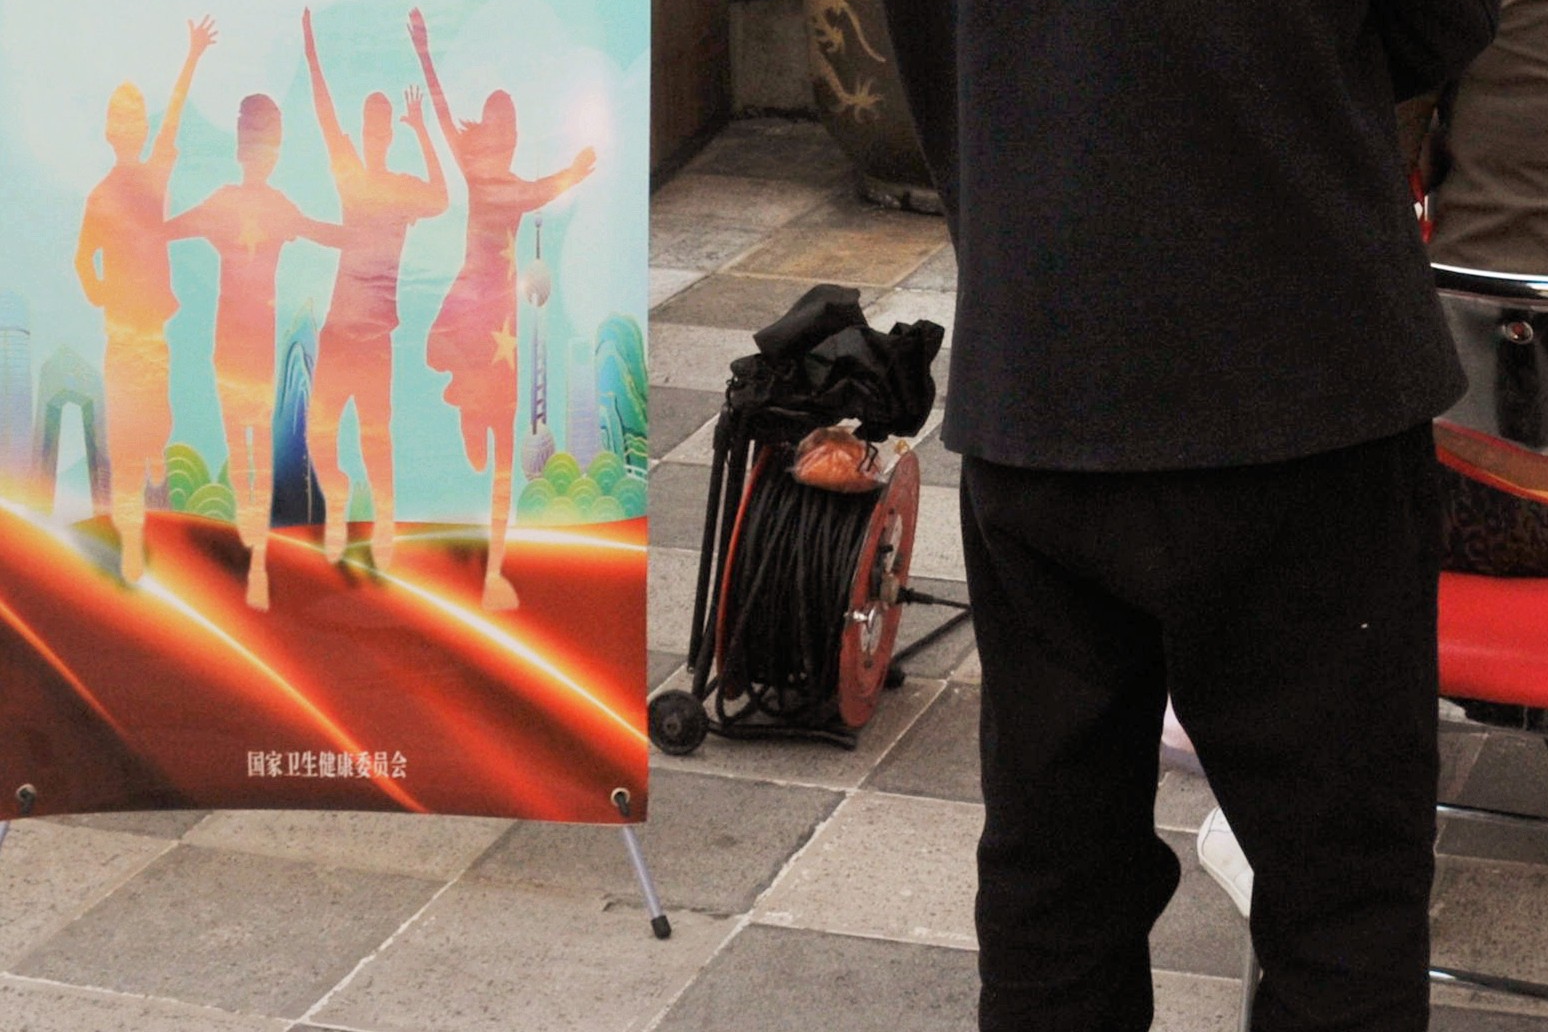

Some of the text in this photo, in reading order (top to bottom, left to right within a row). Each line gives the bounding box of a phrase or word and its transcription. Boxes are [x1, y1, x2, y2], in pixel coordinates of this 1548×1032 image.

[247, 750, 408, 780] 国家卫生健康委员会
